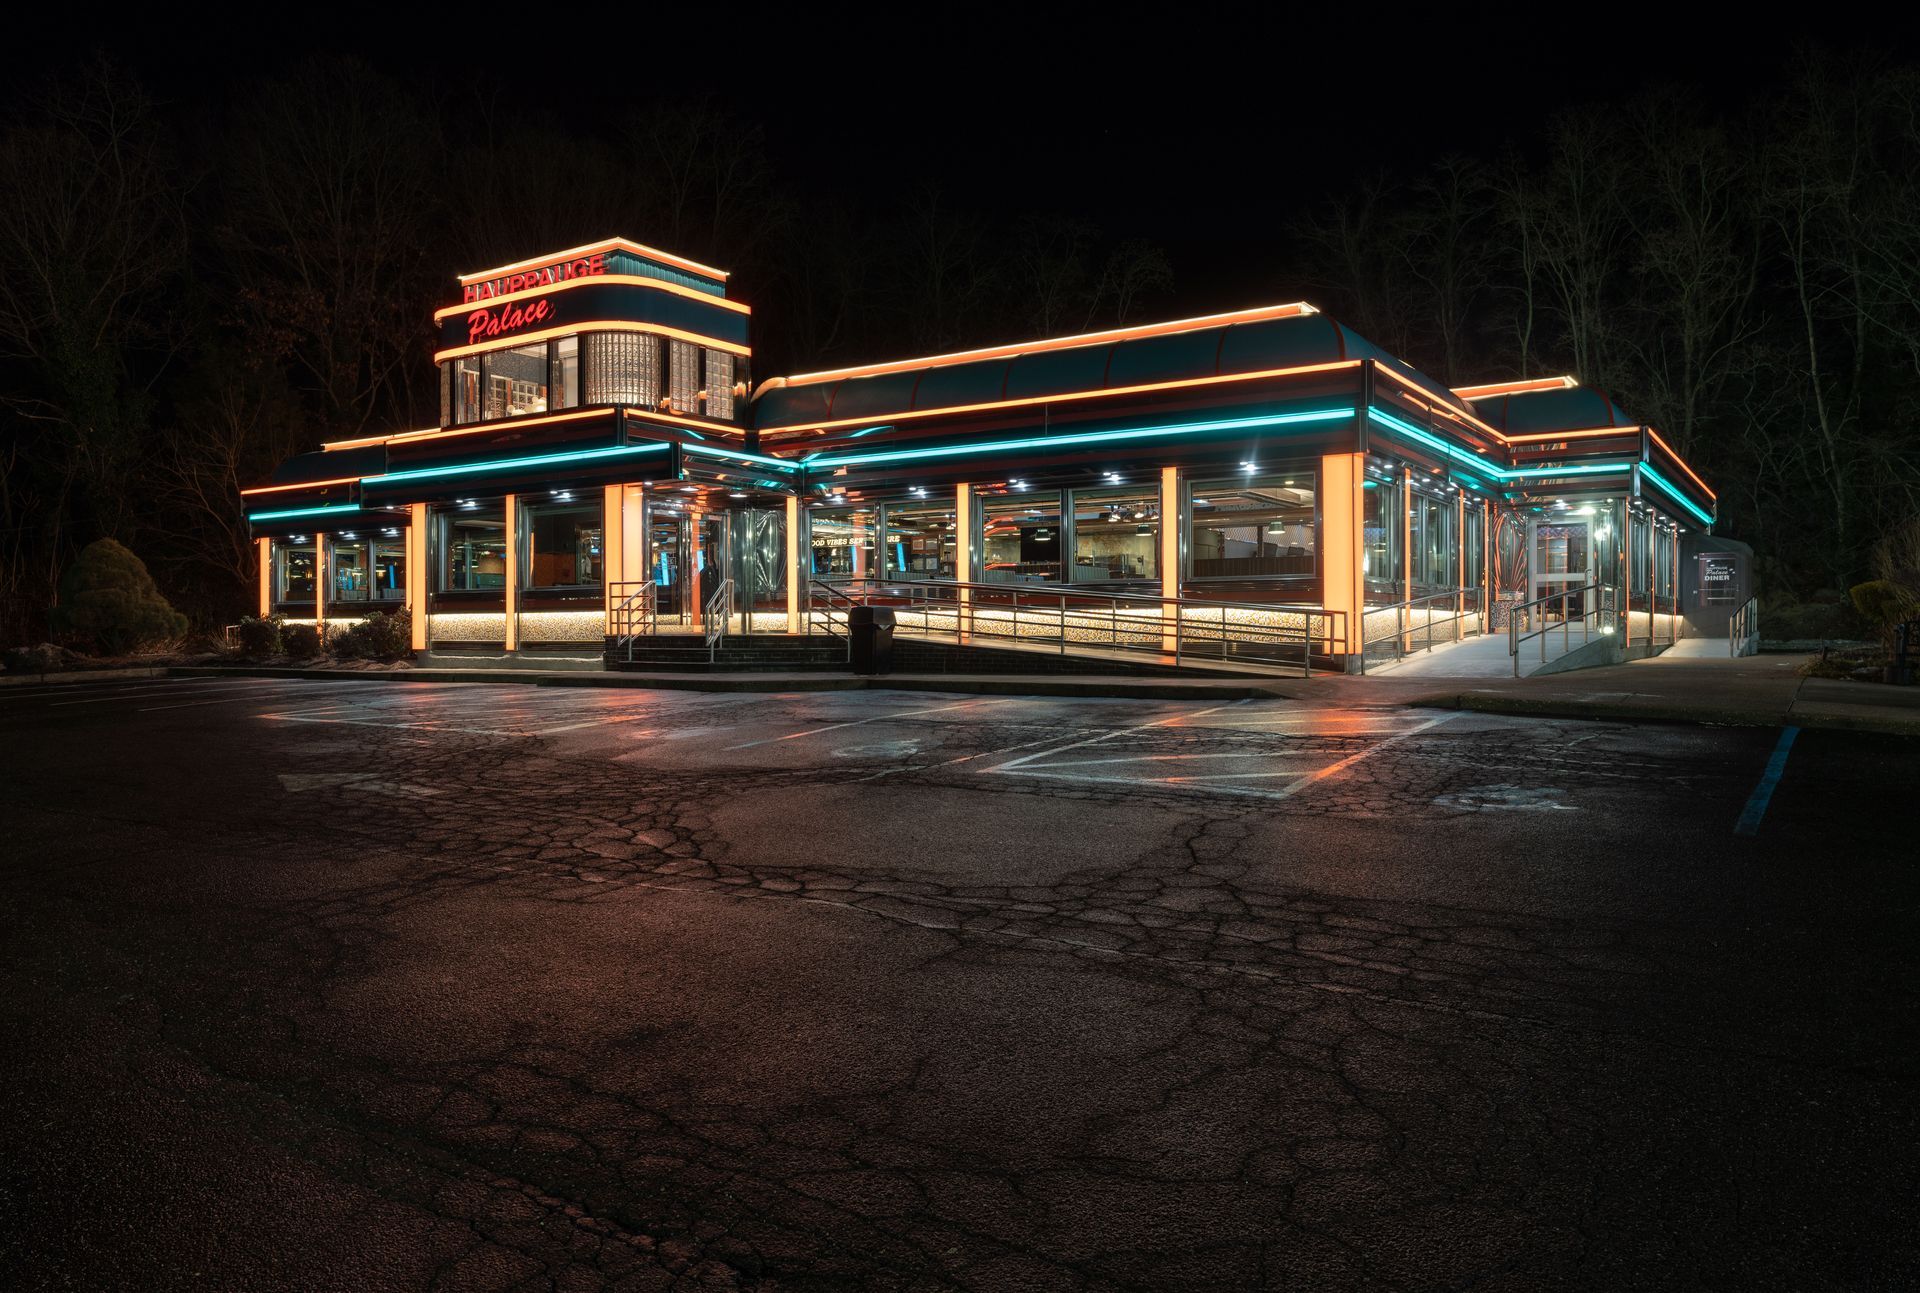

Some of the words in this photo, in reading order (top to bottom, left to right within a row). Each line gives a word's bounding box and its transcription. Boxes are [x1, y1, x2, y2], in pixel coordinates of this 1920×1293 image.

[464, 254, 605, 304] HAUPPAUGE
[467, 299, 550, 345] Palace
[811, 539, 825, 547] OOD
[826, 538, 848, 546] VIBES
